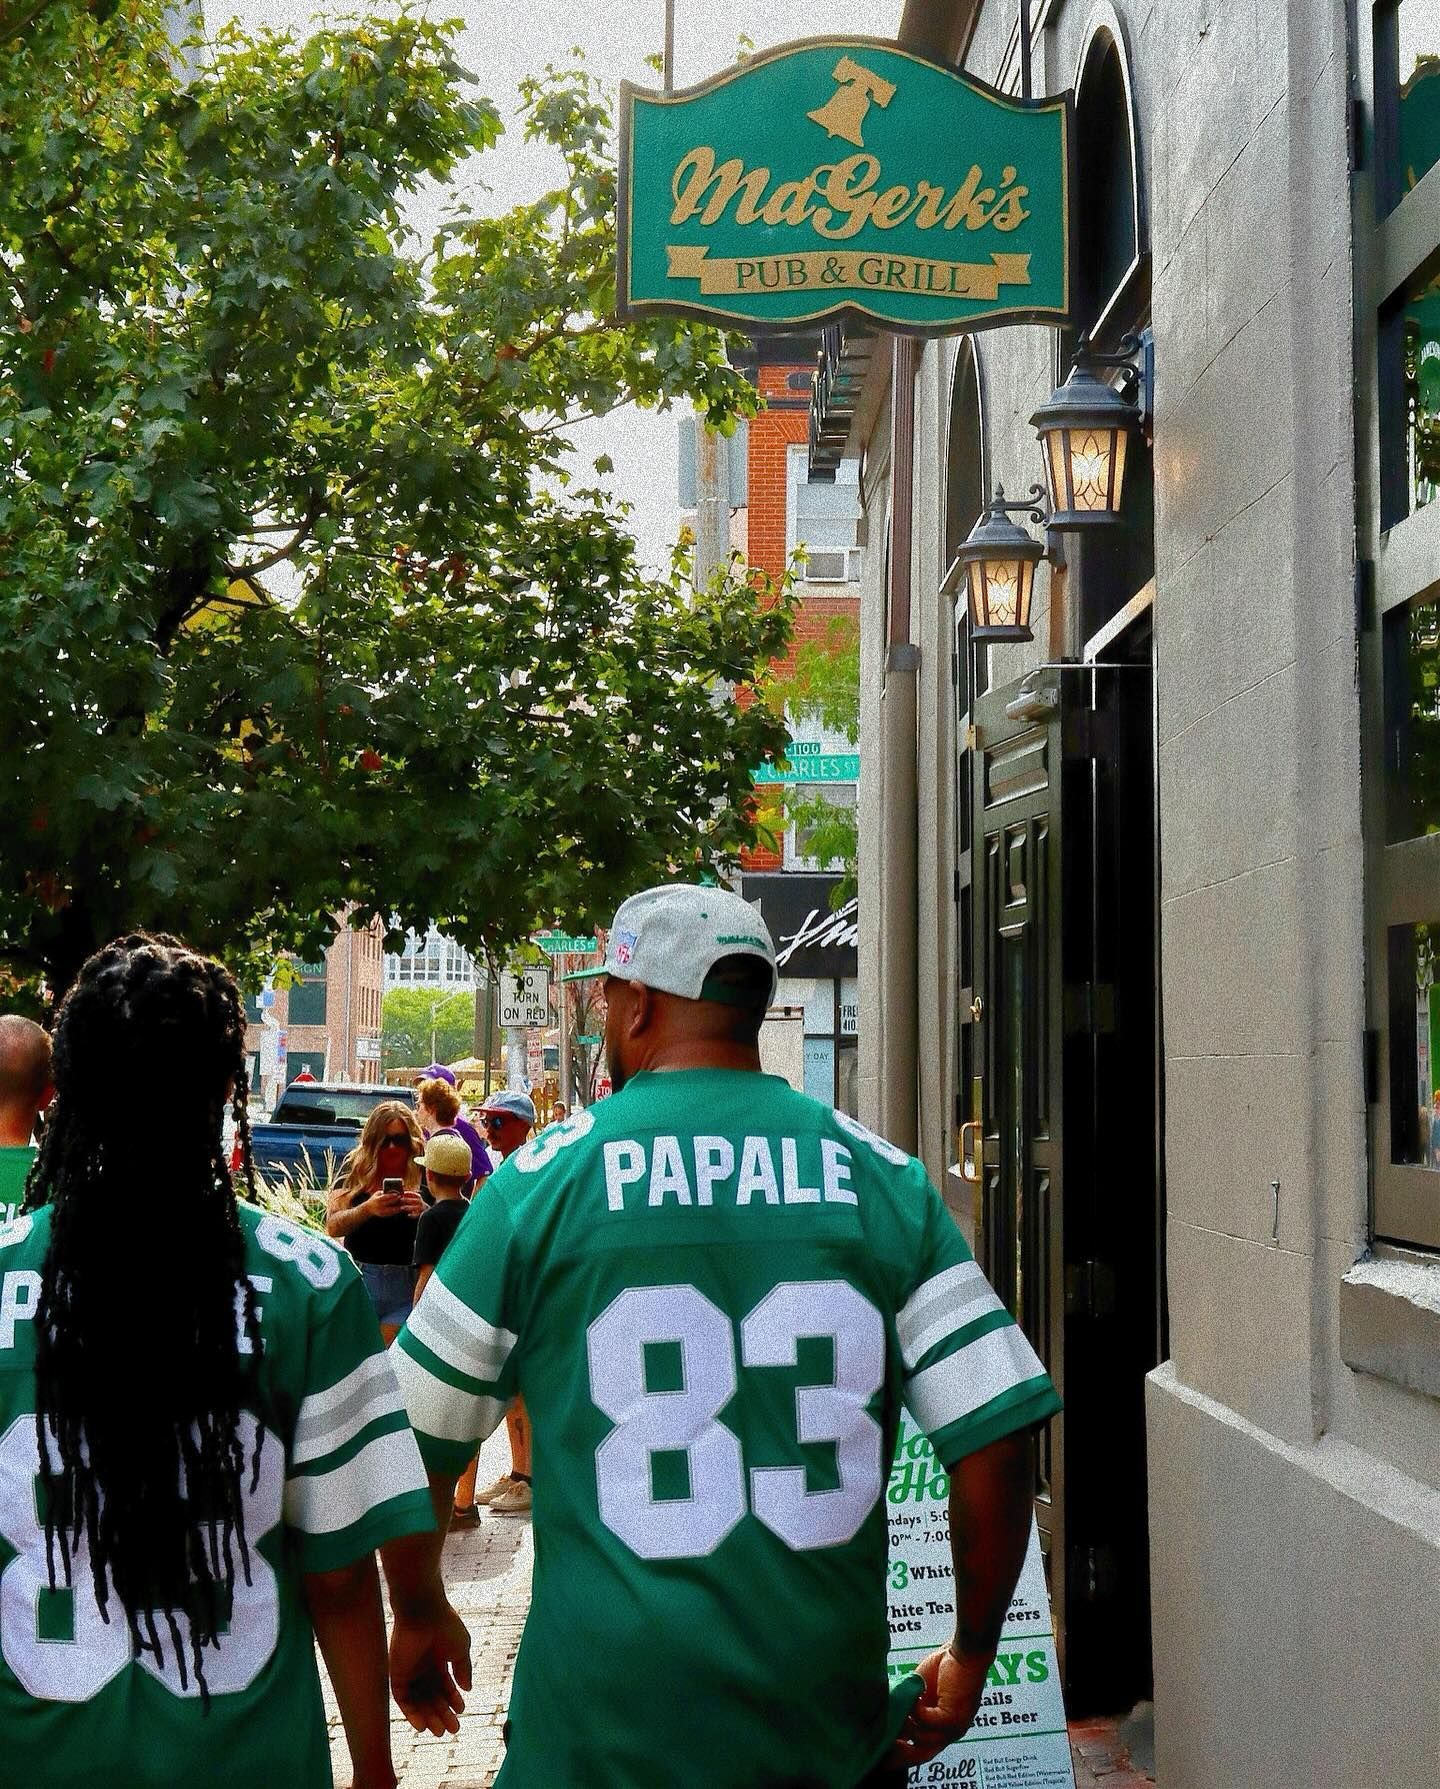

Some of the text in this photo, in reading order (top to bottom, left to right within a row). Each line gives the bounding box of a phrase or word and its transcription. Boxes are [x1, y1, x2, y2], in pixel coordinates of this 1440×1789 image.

[671, 146, 1031, 240] MaGerk's
[735, 256, 971, 294] PUB & GRILL
[512, 992, 539, 1004] TURN
[504, 1008, 546, 1020] ON RED
[843, 1005, 858, 1018] FRE
[813, 1052, 829, 1060] DAY
[596, 1086, 612, 1096] STO
[603, 1135, 859, 1212] PAPALE
[256, 1216, 342, 1290] 8
[586, 1278, 887, 1560] 83
[887, 1601, 955, 1618] hite Tea
[1009, 1598, 1028, 1607] oz.
[1005, 1610, 1041, 1622] eers
[1000, 1711, 1038, 1725] Beer
[927, 1758, 977, 1782] Bull
